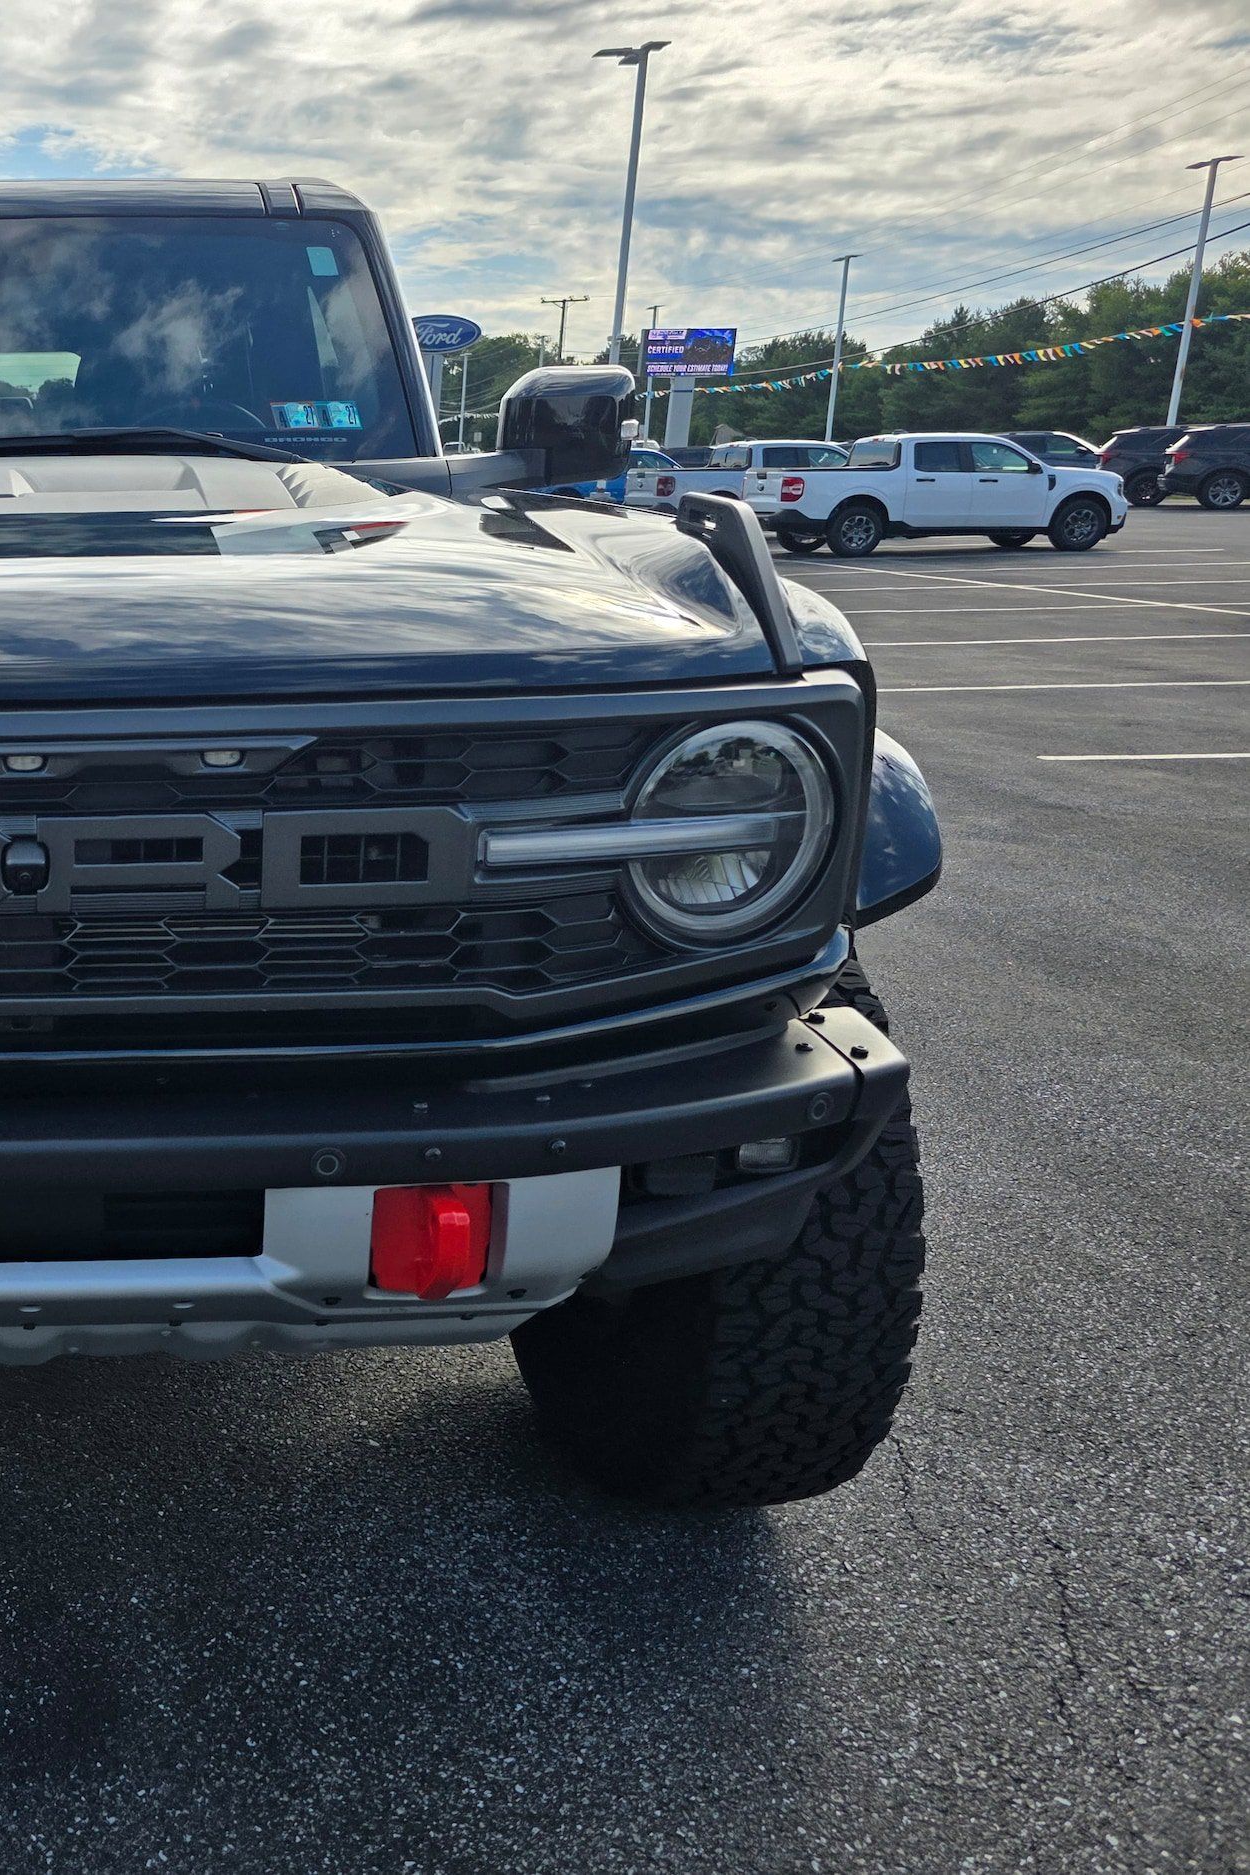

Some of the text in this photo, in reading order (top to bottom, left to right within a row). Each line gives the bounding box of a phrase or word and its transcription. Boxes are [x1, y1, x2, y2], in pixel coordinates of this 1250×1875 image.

[416, 322, 463, 345] Ford
[647, 345, 684, 354] CERTIFIED
[303, 405, 315, 426] 27
[345, 405, 357, 425] 27
